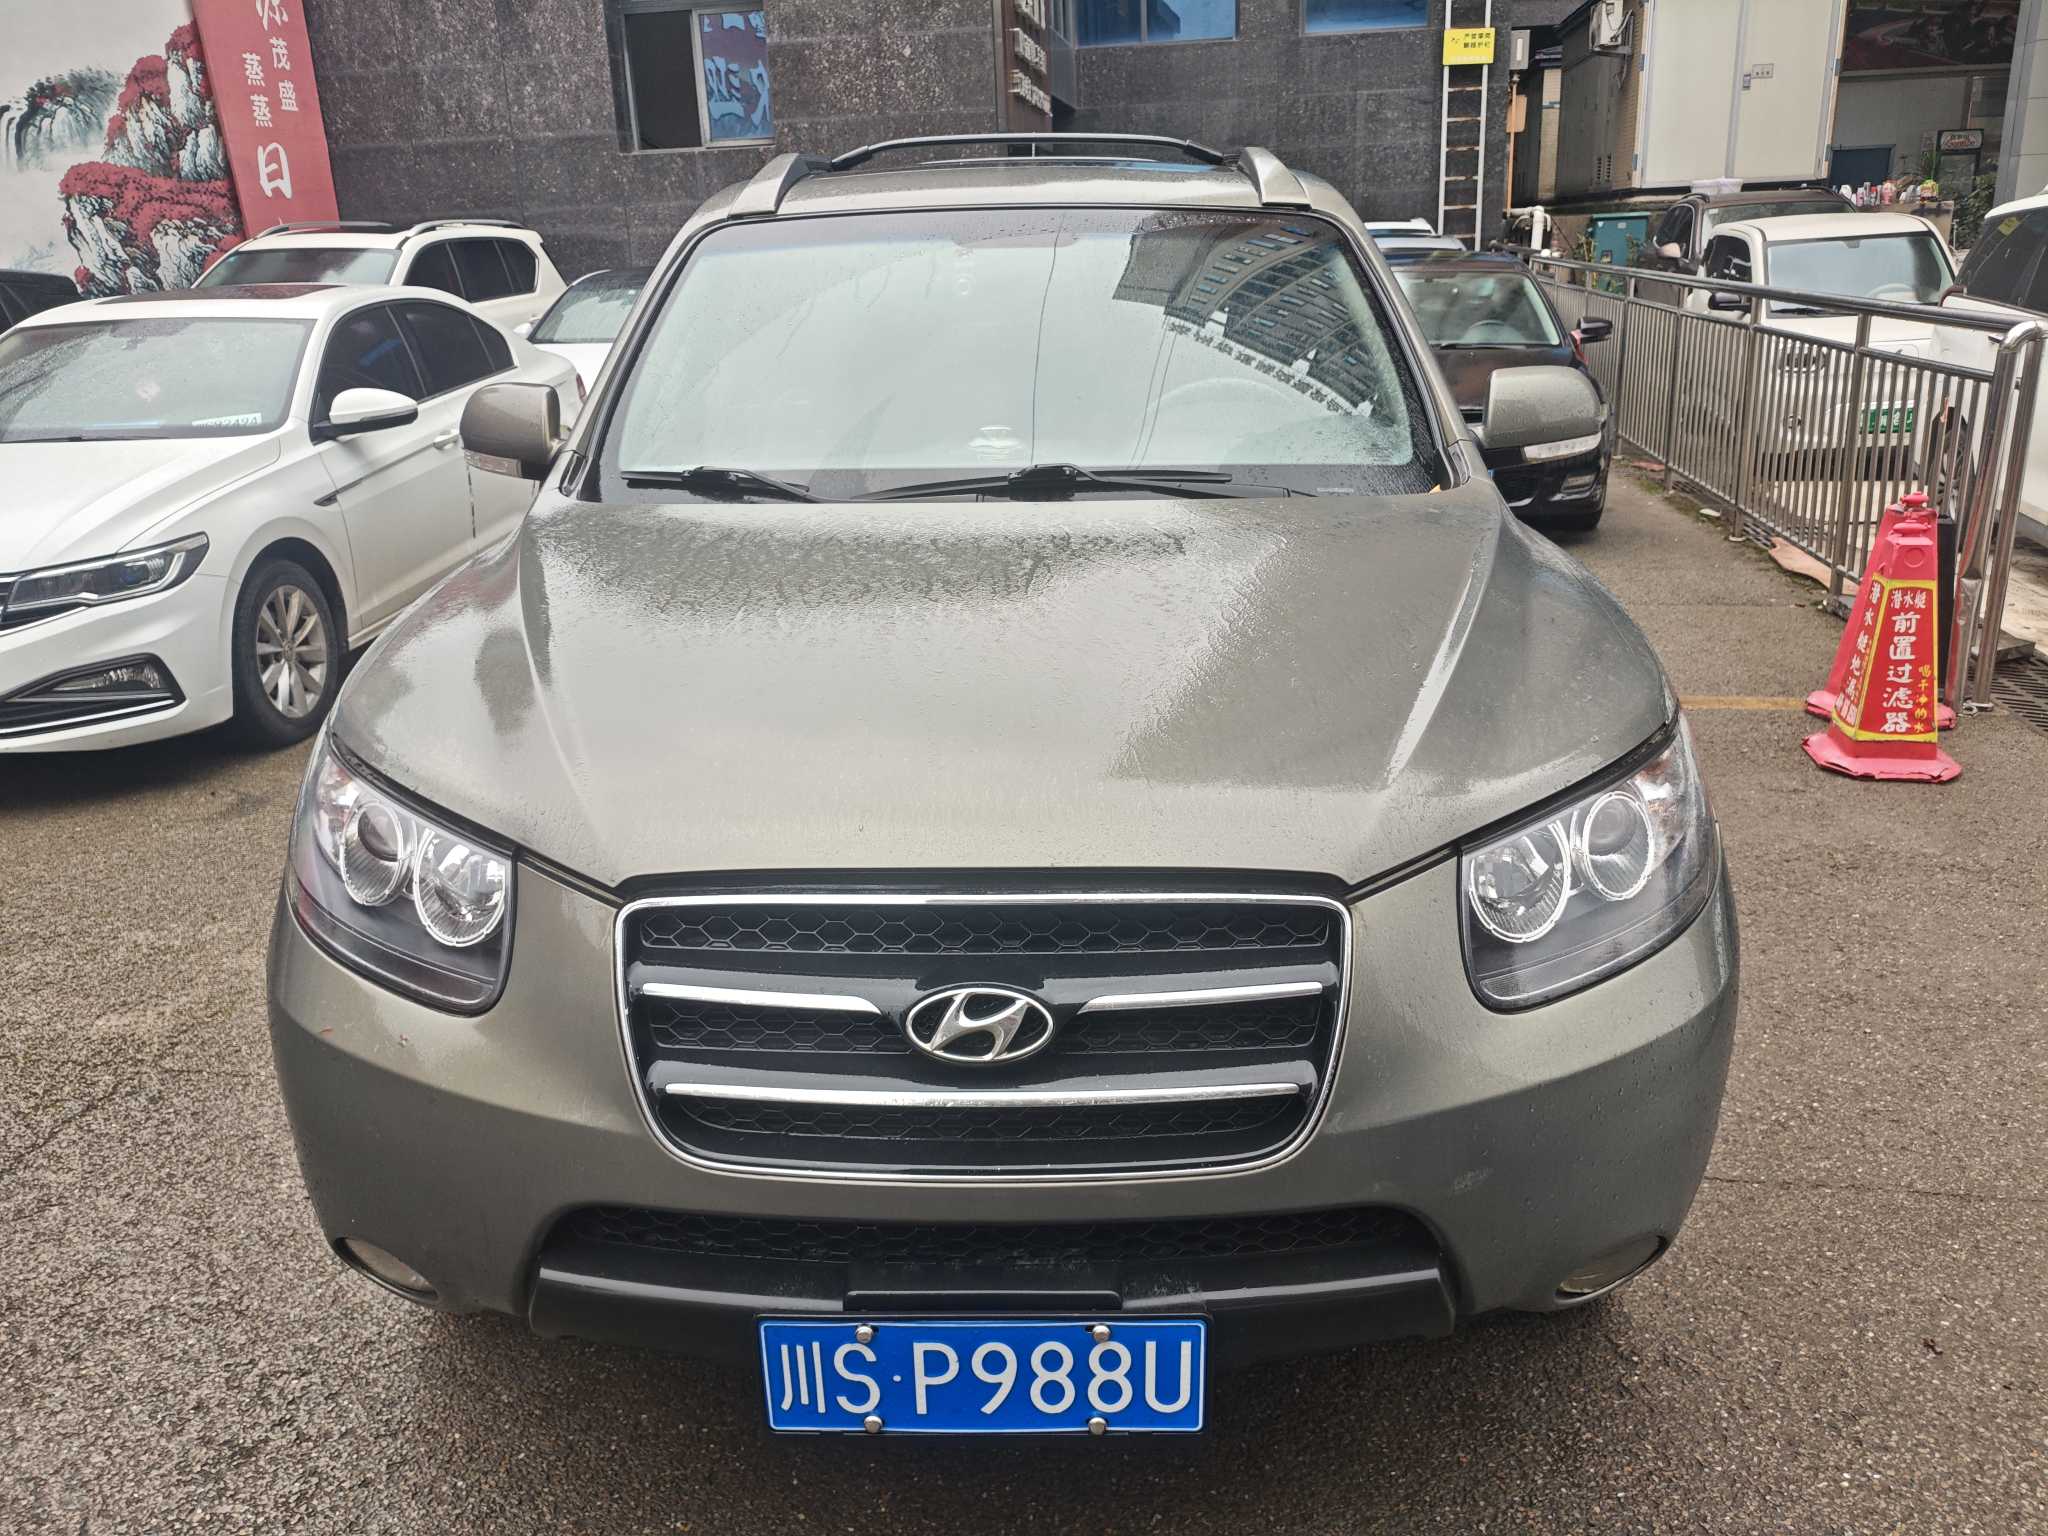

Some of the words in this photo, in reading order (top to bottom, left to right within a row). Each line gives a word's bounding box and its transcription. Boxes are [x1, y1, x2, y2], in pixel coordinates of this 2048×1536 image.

[242, 52, 293, 225] 蒸蒸日
[1891, 590, 1927, 608] 潜水艇
[1880, 611, 1920, 733] 前置过滤器
